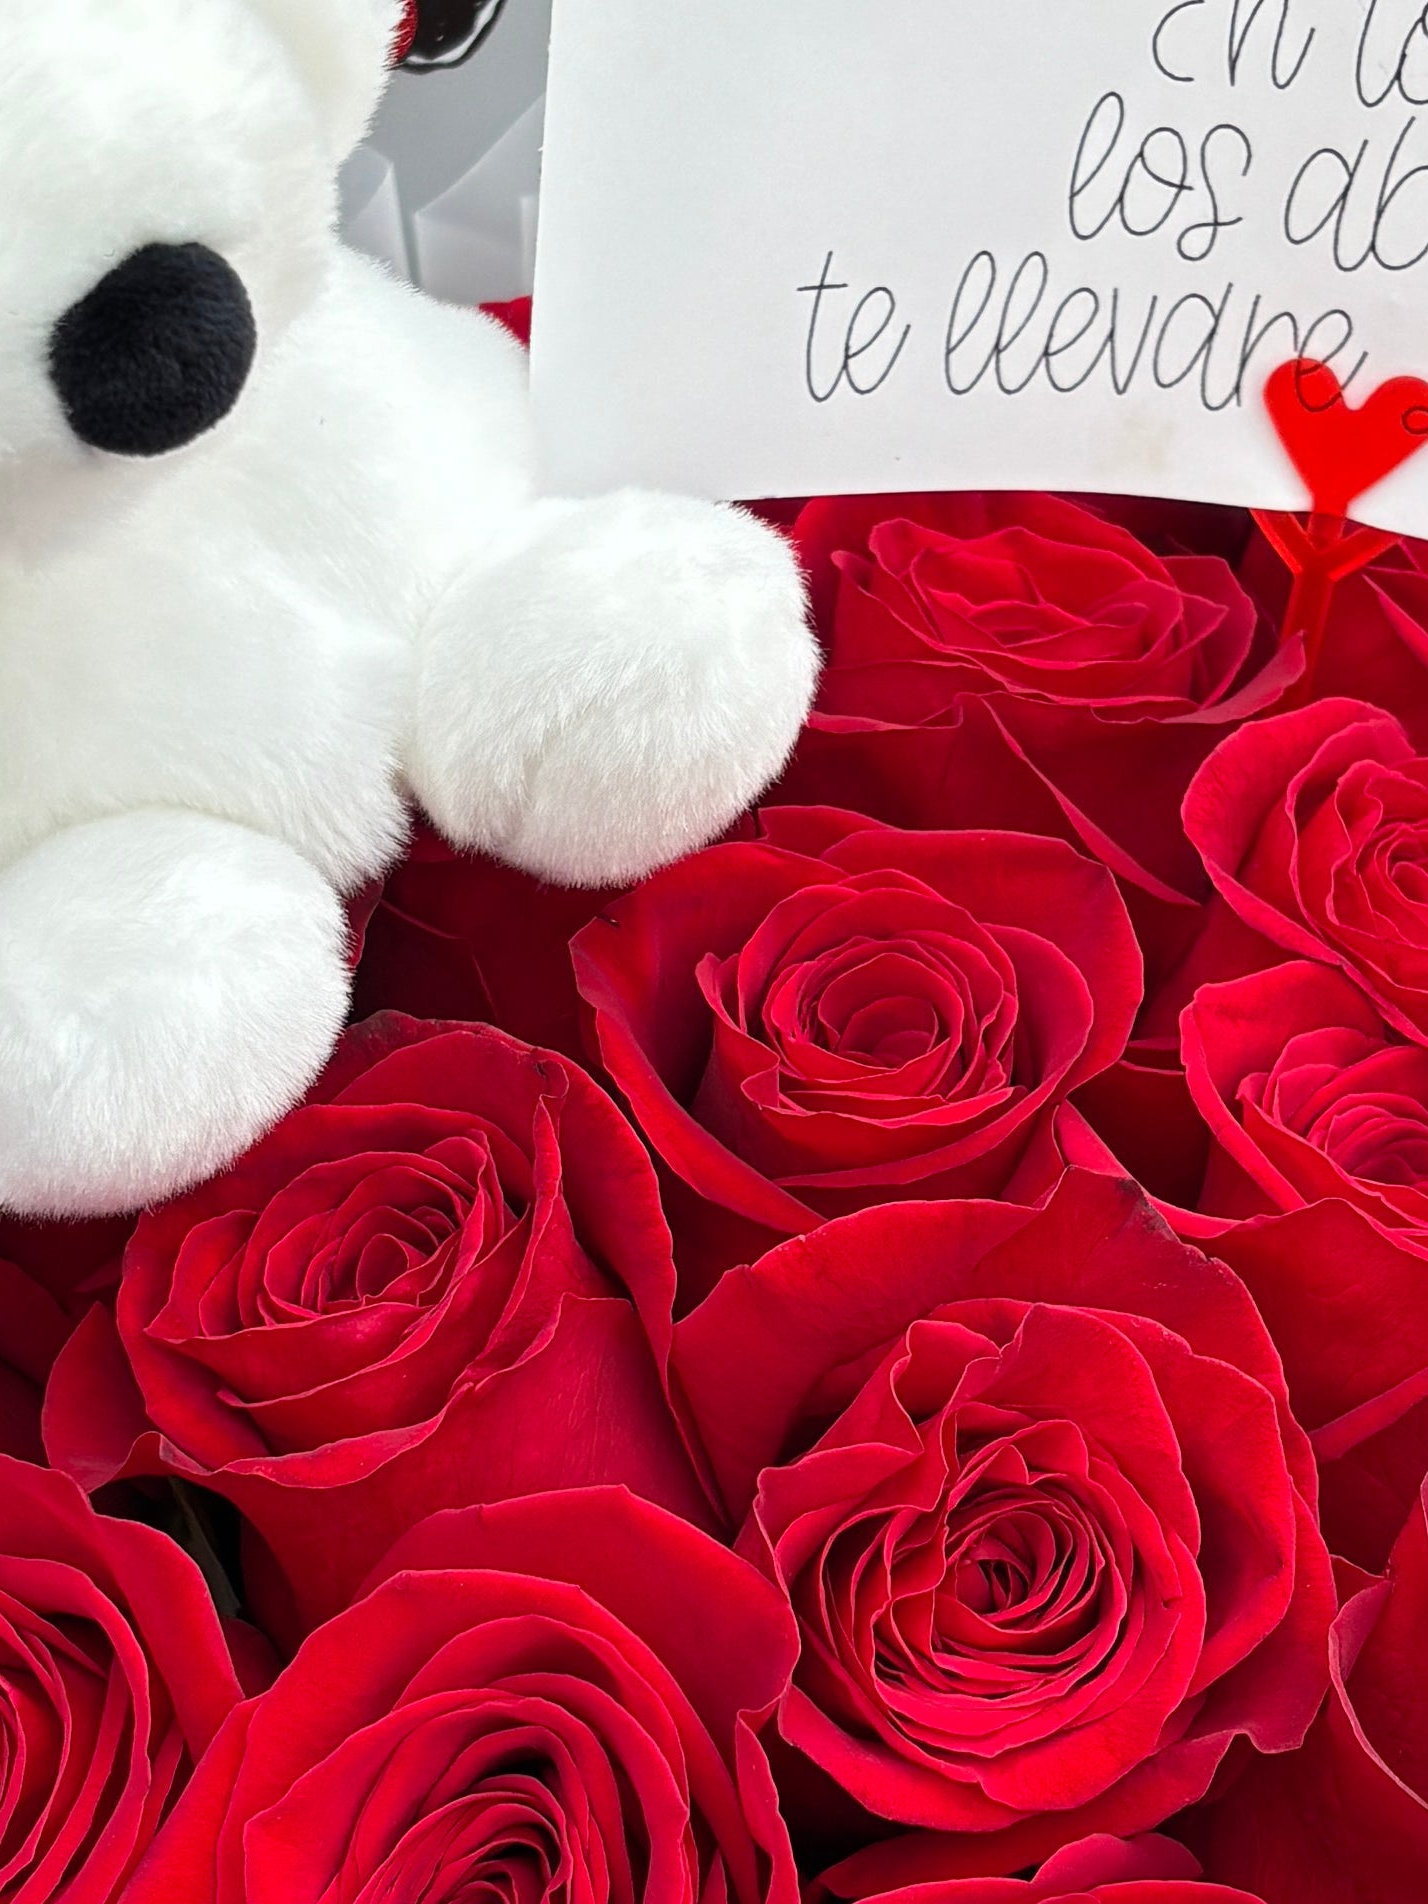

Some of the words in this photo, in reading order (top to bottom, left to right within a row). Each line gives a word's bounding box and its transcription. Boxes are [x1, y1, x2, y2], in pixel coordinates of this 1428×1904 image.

[1068, 90, 1253, 262] los
[797, 250, 911, 403] te
[944, 249, 1369, 413] llevare
